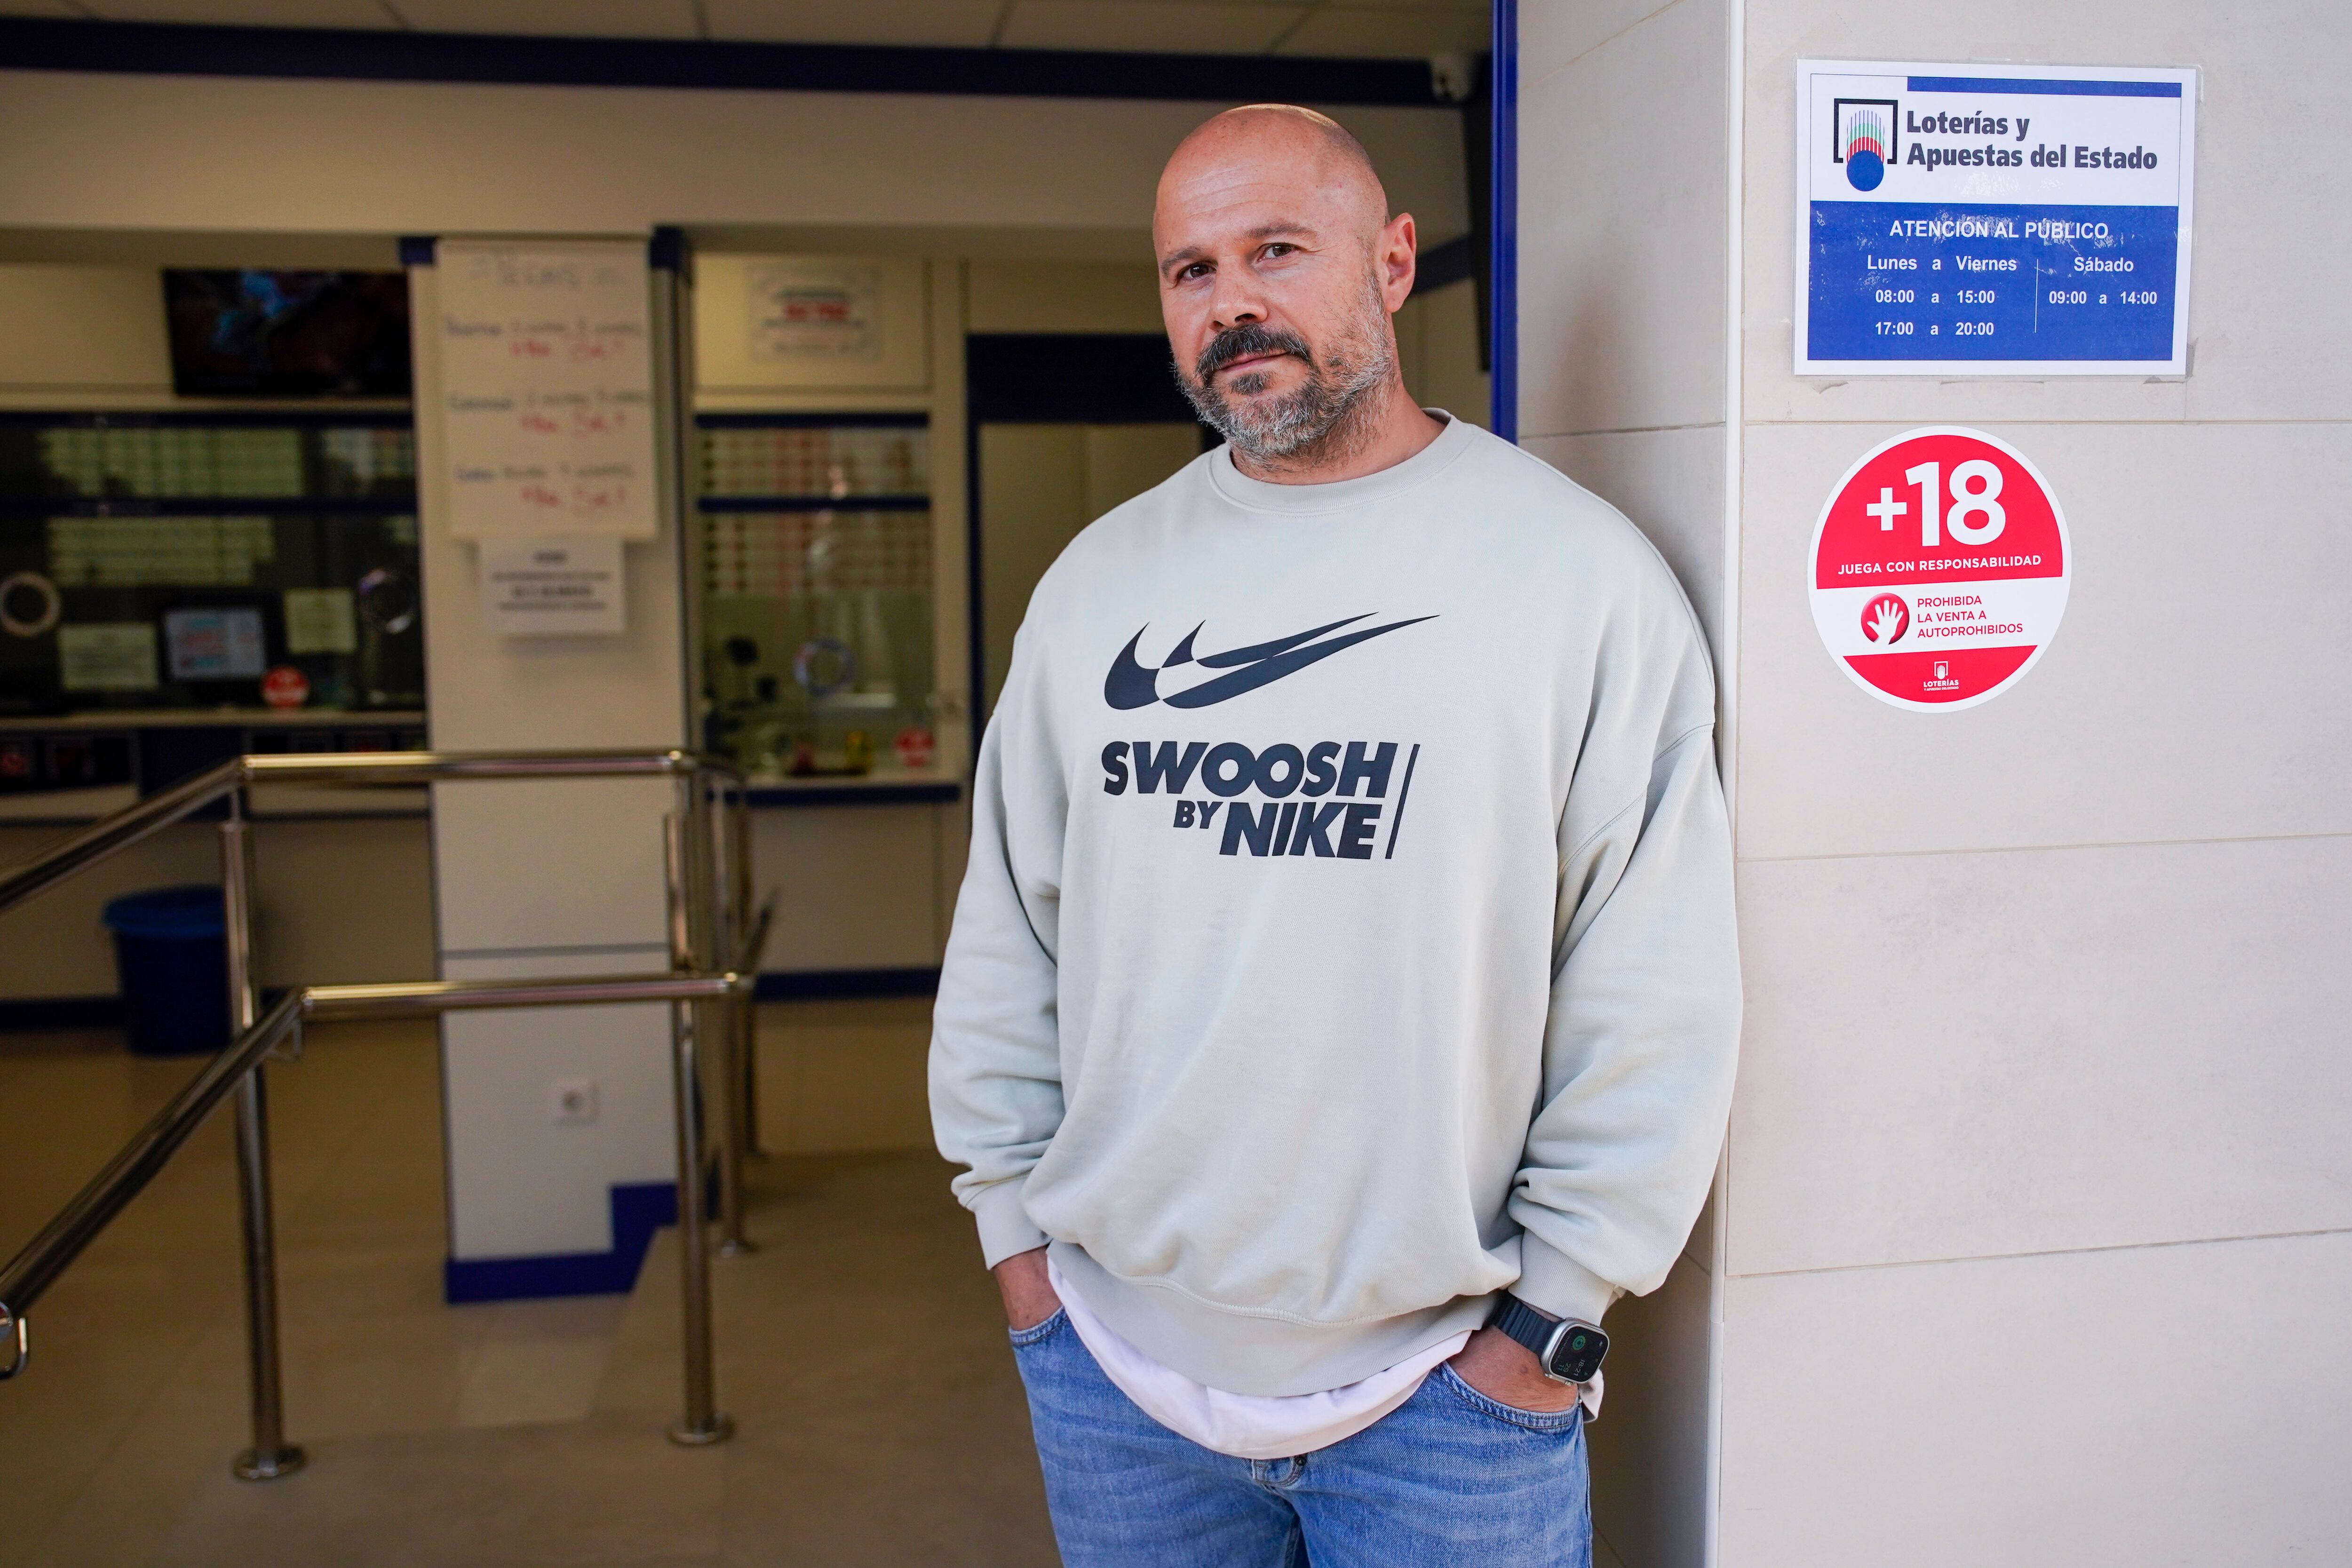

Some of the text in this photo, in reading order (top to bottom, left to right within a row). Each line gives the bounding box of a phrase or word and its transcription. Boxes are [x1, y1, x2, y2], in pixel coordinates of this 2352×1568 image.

[1907, 110, 2030, 142] Loterías y
[1907, 143, 2157, 172] Apuestas del Estado
[1889, 217, 2109, 239] ATENCIÓN AL PÚBLICO
[1867, 255, 2018, 272] Lunes a Viernes
[2074, 256, 2134, 272] Sábado
[1875, 289, 1995, 303] 08:00 a 15:00
[2049, 291, 2157, 304] 09:00 a 14:00
[1875, 321, 1994, 335] 17:00 a 20:00
[1866, 459, 2006, 547] +18
[1838, 555, 2041, 575] JUEGA CON RESPONSABILIDAD
[1917, 595, 1982, 608] PROHIBIDA
[1918, 610, 1986, 623] LA VENTA A
[1917, 623, 2023, 638] AUTOPROHIBIDOS
[1923, 678, 1959, 687] LOTERÍAS
[1101, 741, 1398, 798] SWOOSH
[1173, 800, 1383, 860] BY NIKE
[1573, 1360, 1586, 1376] 18:21
